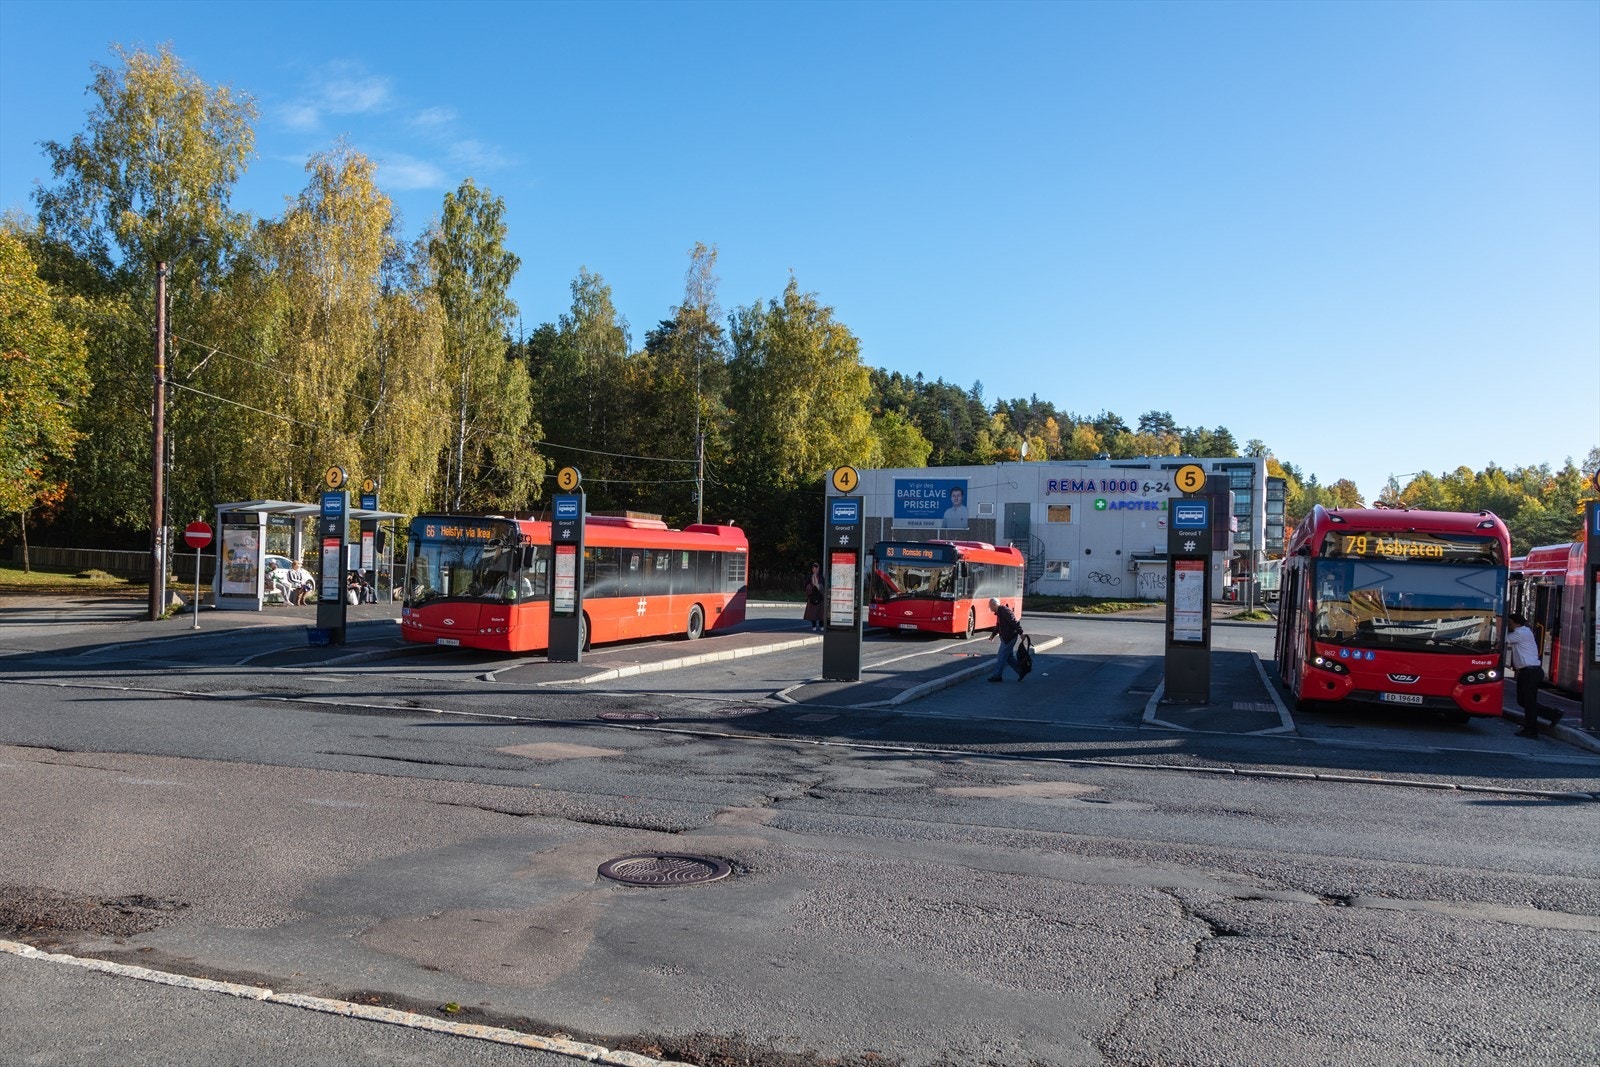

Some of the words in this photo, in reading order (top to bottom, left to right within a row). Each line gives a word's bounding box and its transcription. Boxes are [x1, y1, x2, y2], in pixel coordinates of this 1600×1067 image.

[331, 471, 338, 483] 2
[563, 472, 572, 485] 3
[840, 472, 850, 485] 4
[1184, 471, 1196, 487] 5
[1048, 479, 1096, 492] REMA
[1101, 479, 1139, 492] 1000
[1142, 482, 1171, 492] 6-24
[897, 489, 922, 498] BARE
[923, 489, 947, 498] LAVE
[903, 500, 940, 509] PRISER!
[1109, 501, 1160, 510] APOTEK
[1161, 501, 1168, 510] 1
[426, 524, 436, 538] 66
[441, 526, 464, 539] Helsfyr
[465, 527, 477, 538] via
[477, 528, 491, 539] Ikea
[1346, 536, 1367, 554] 79
[922, 550, 933, 559] ring
[1399, 694, 1421, 703] 19648
